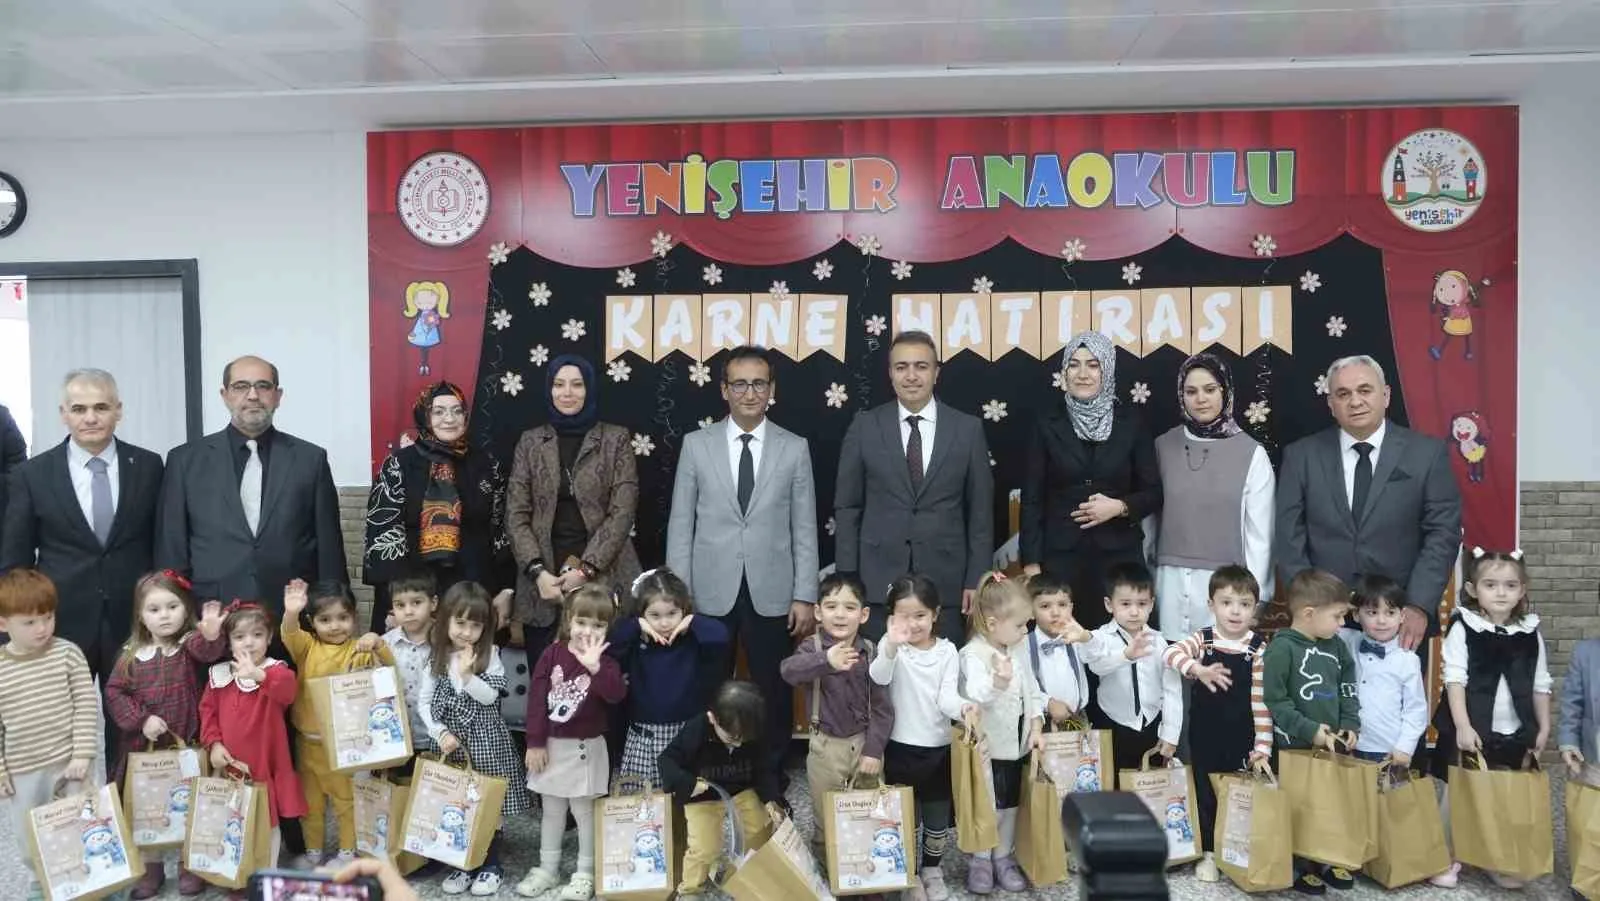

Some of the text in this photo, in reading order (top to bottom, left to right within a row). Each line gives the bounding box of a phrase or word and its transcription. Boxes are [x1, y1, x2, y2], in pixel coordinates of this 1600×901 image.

[559, 150, 1296, 220] YENİŞEHİR ANAOKULU
[611, 290, 1274, 349] KARNE HATIRASI
